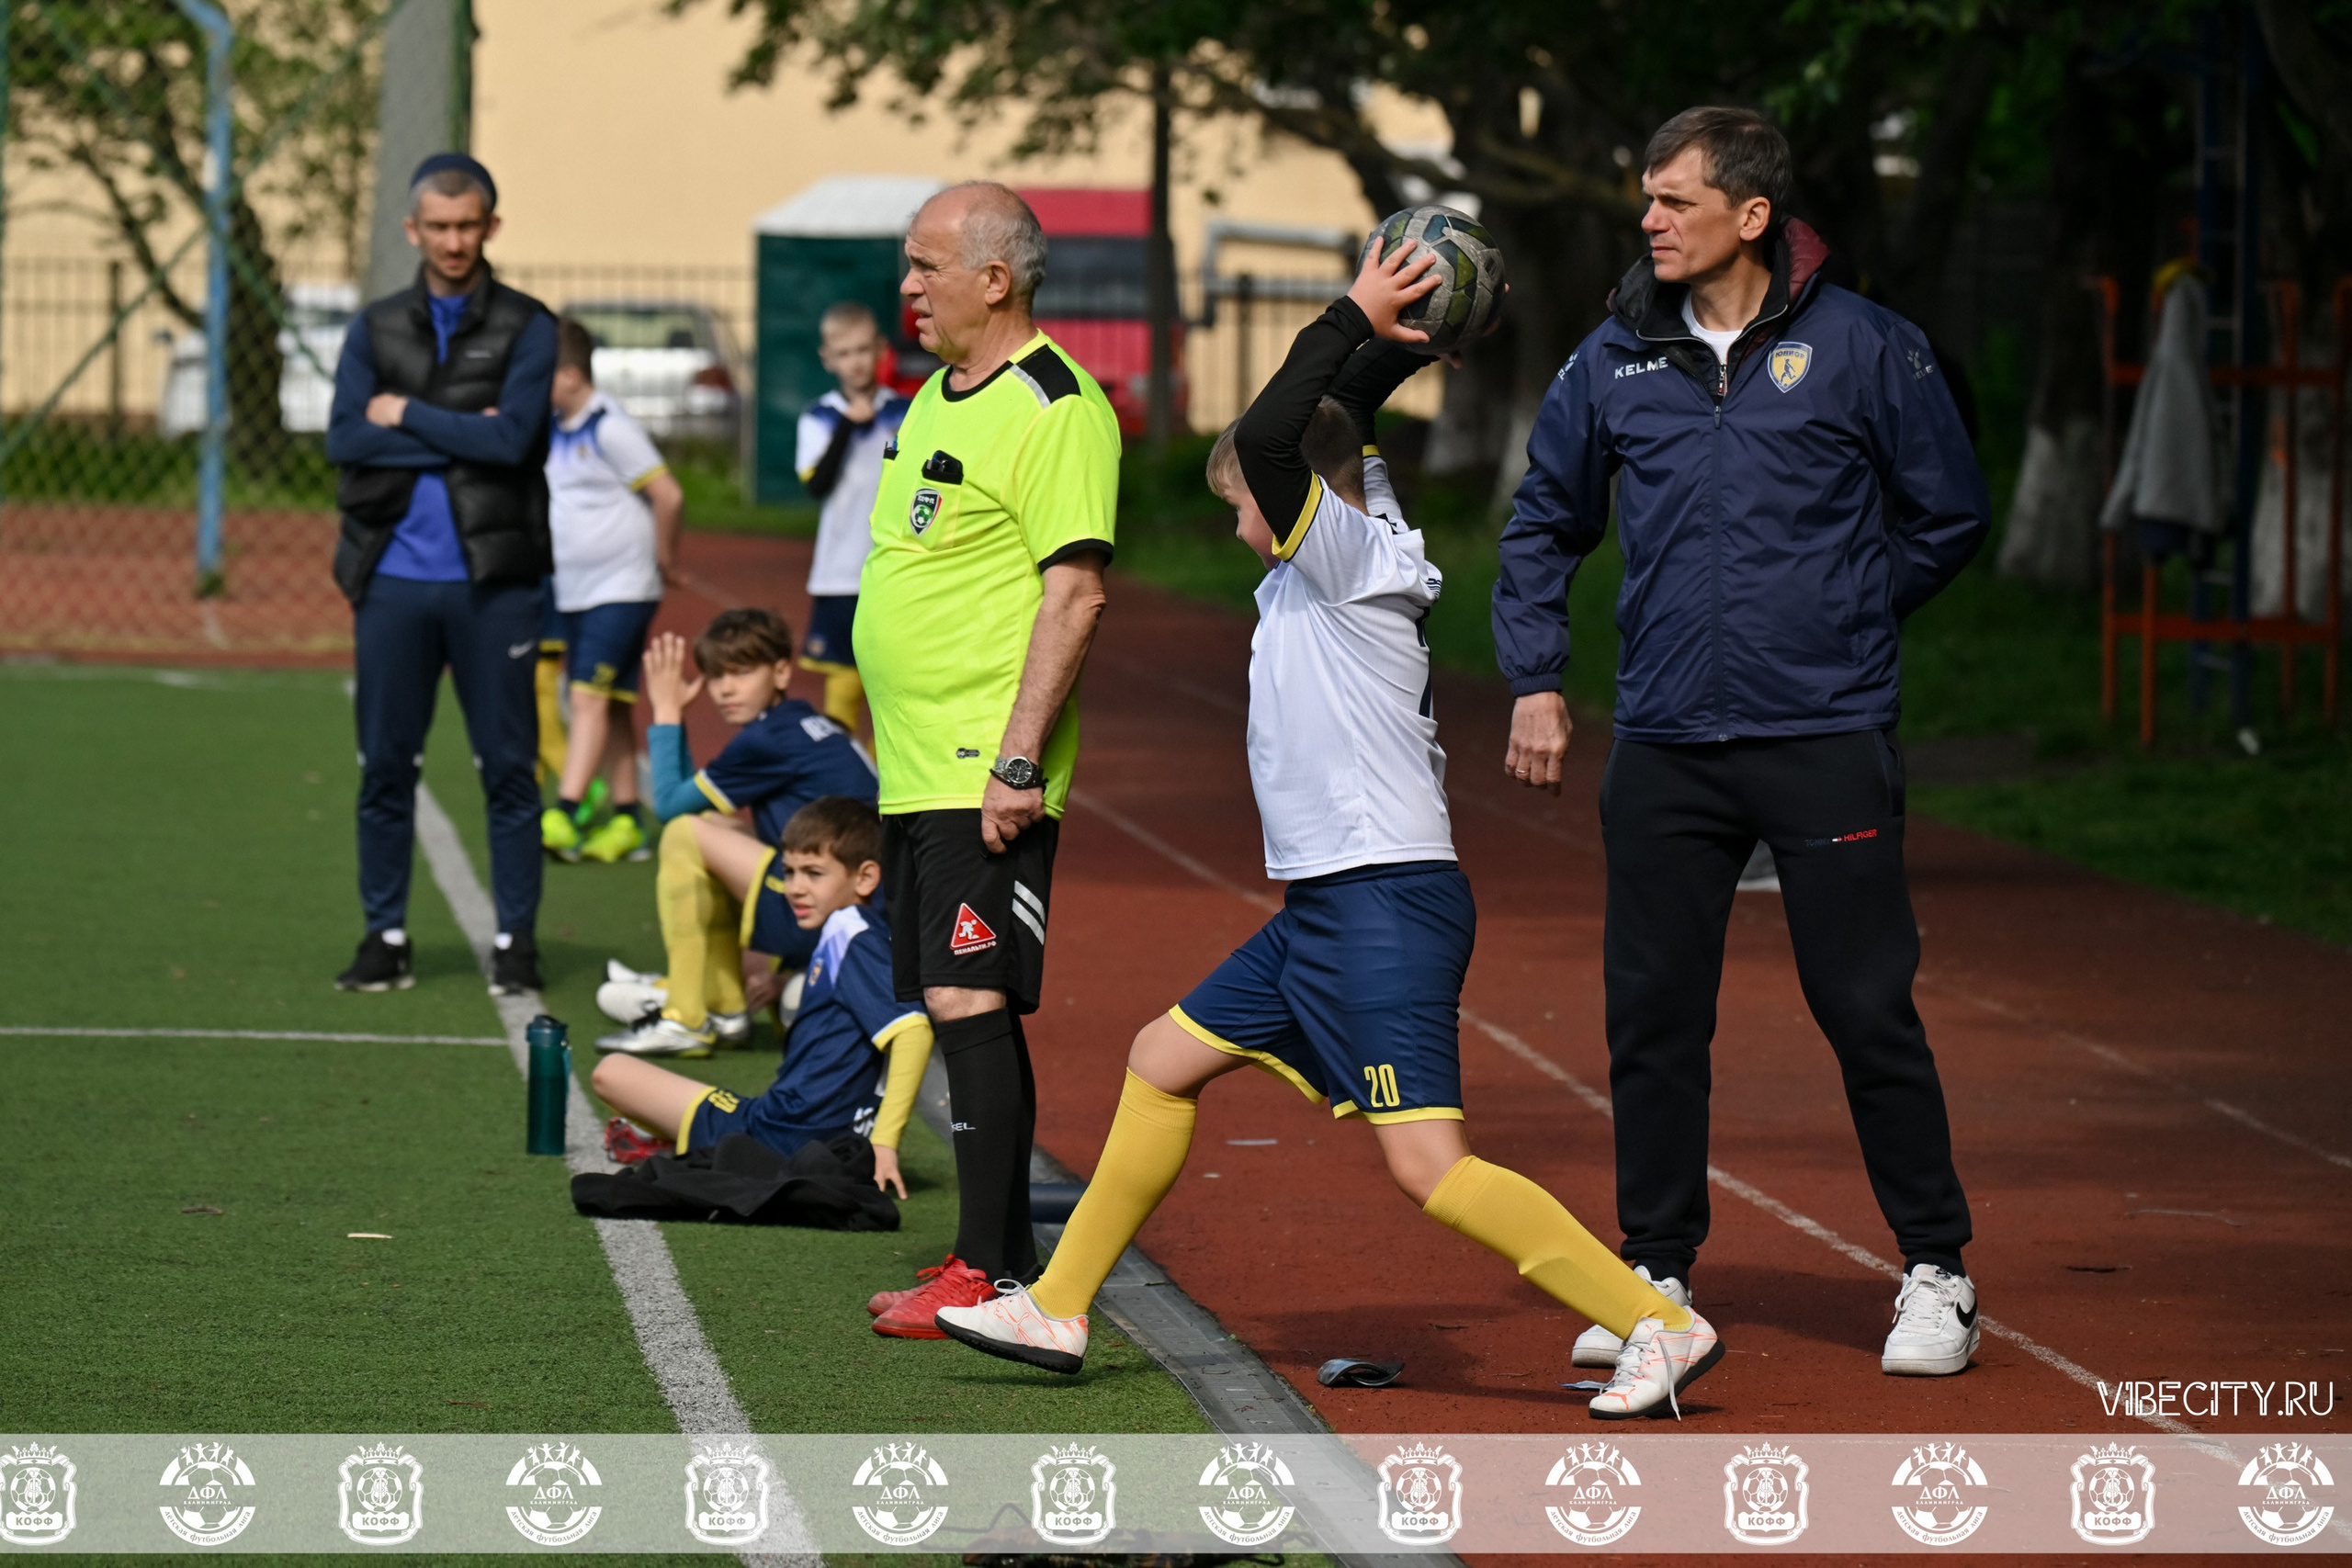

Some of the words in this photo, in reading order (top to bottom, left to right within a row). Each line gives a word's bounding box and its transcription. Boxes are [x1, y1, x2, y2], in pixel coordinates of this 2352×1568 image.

[1614, 356, 1668, 379] KELME
[1843, 829, 1878, 841] HILFIGER
[1363, 1064, 1400, 1108] 20
